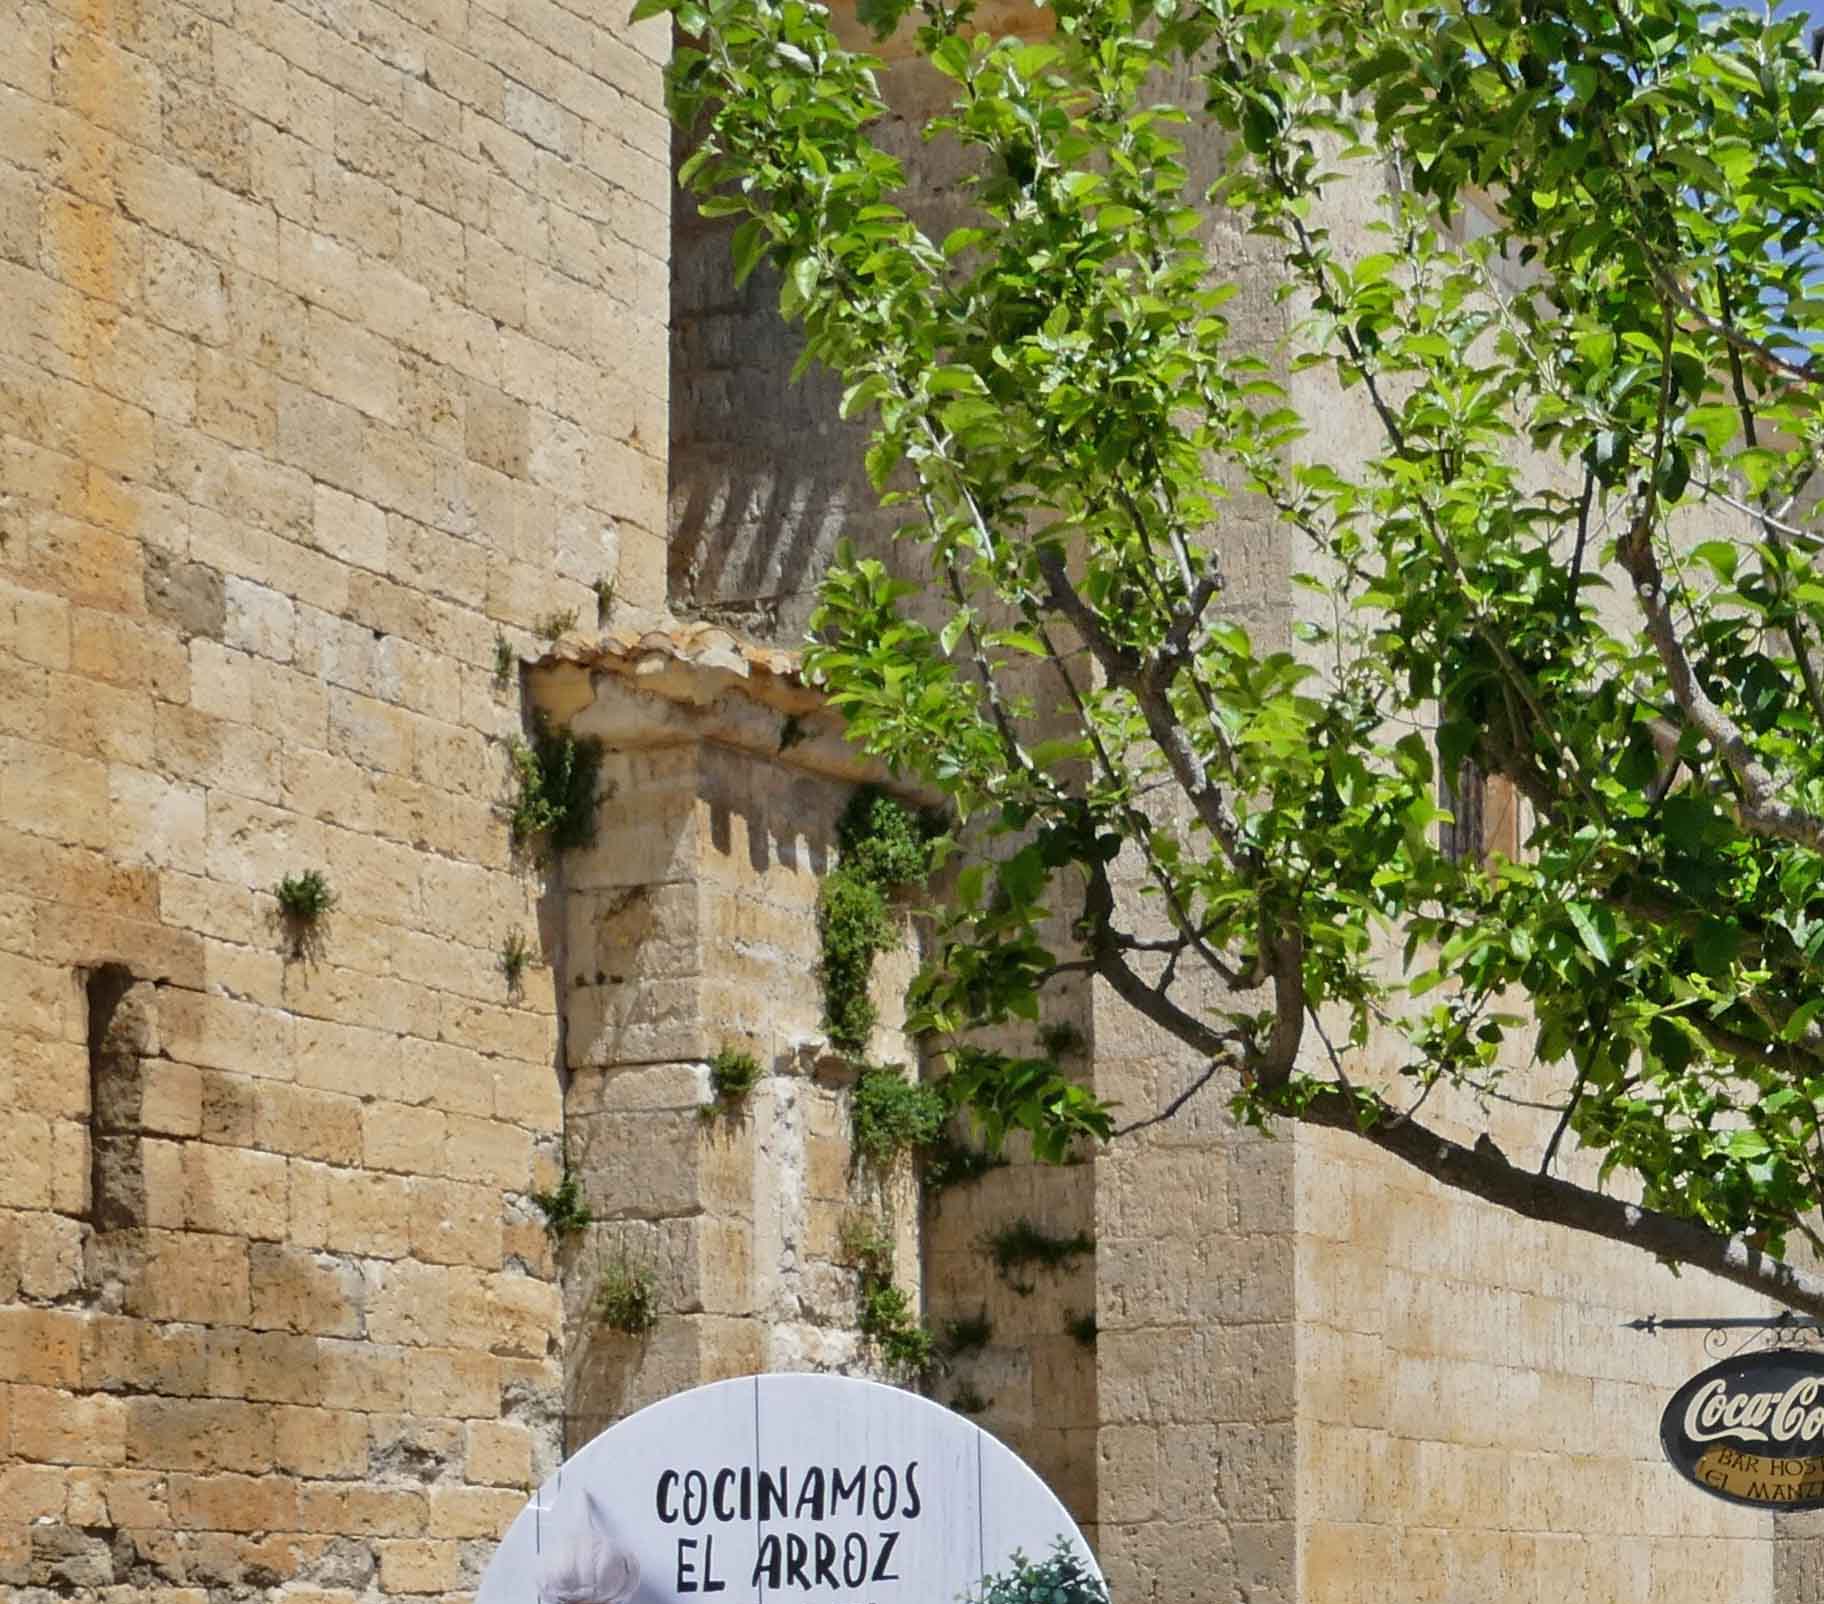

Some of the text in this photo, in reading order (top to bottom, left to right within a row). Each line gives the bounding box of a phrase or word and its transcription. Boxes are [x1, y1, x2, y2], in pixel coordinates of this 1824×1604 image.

[1718, 1447, 1759, 1474] BAR
[656, 1462, 921, 1525] COCINAMOS
[677, 1532, 900, 1593] EL ARROZ
